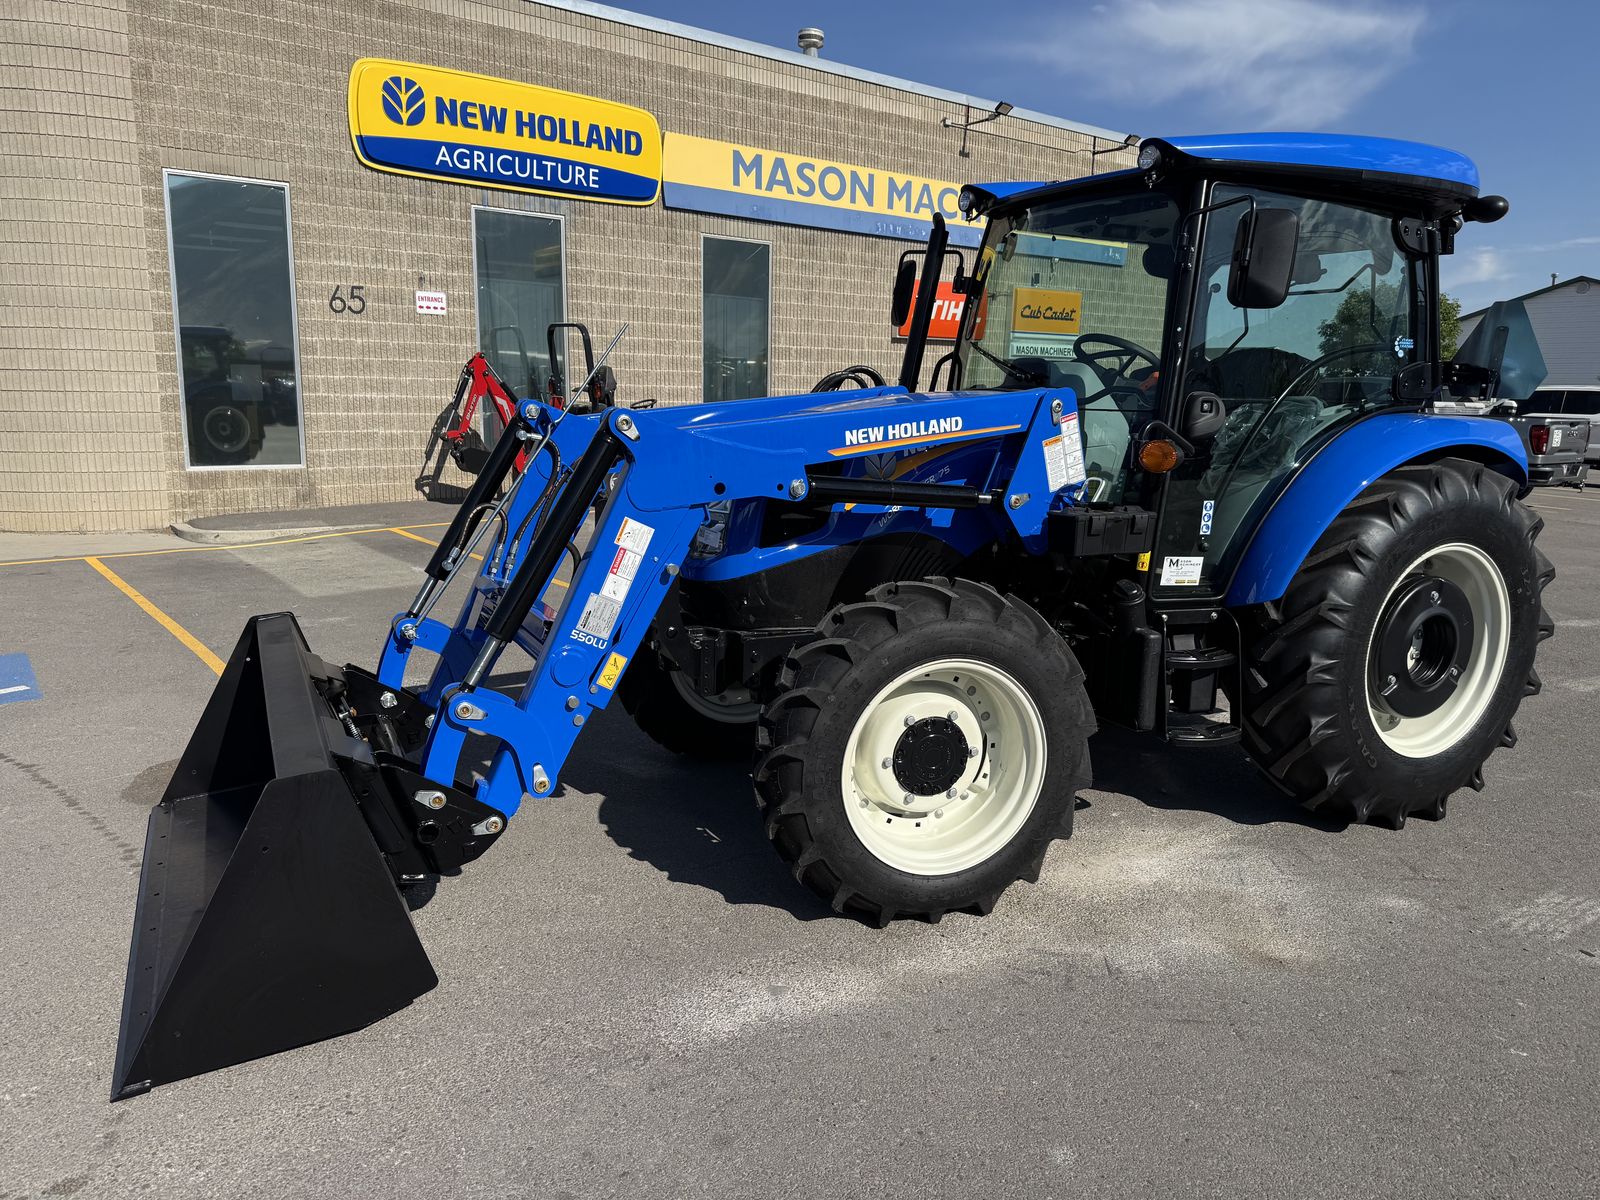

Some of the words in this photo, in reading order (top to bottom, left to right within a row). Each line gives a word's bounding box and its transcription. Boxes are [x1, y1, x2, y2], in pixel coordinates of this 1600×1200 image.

[435, 96, 508, 134] NEW
[515, 109, 643, 157] HOLLAND
[435, 145, 600, 189] AGRICULTURE
[732, 149, 875, 208] MASON
[329, 284, 366, 315] 65
[417, 295, 444, 304] ENTRANCE
[1020, 304, 1042, 320] Cub
[1042, 306, 1077, 322] Cadet
[1015, 345, 1039, 355] MASON
[844, 426, 885, 446] NEW
[887, 416, 963, 441] HOLLAND
[569, 629, 608, 650] 550LU
